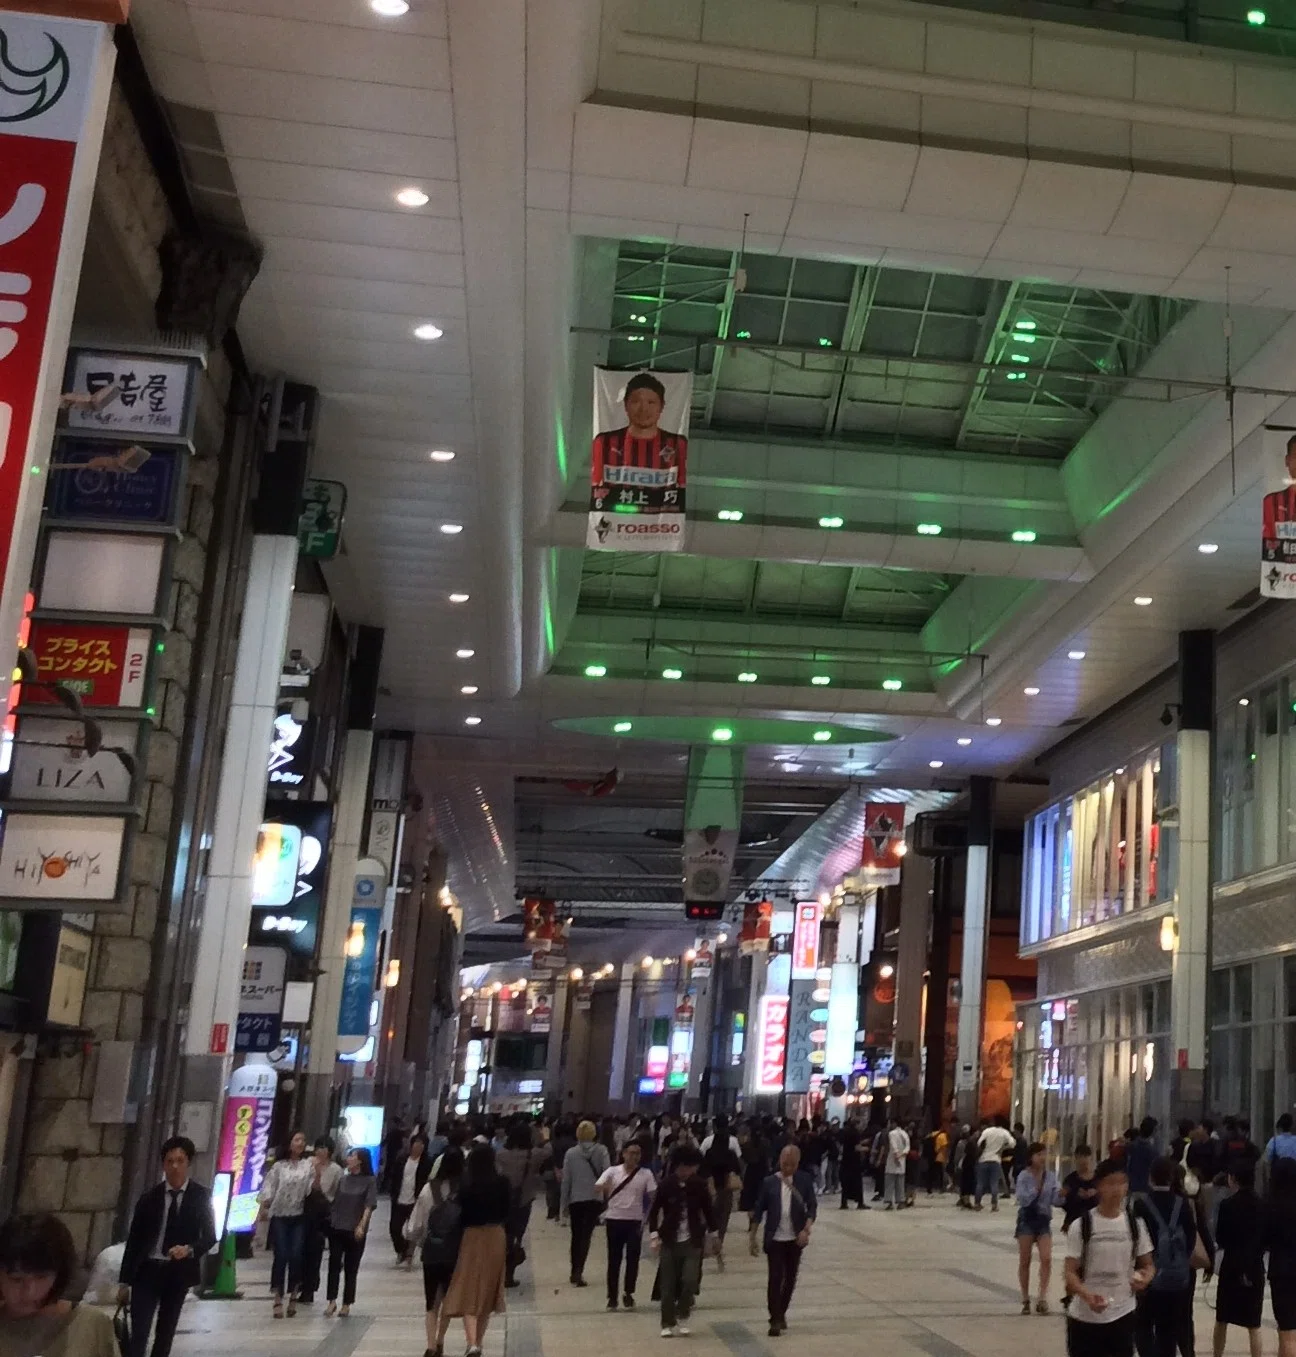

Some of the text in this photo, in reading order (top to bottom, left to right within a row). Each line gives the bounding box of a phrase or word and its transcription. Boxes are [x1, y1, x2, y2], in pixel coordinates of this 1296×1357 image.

[605, 467, 676, 484] Hirata
[616, 523, 680, 534] roasso
[38, 656, 118, 675] コンタクト
[37, 768, 104, 790] LIZA
[762, 1002, 788, 1082] カラオケ
